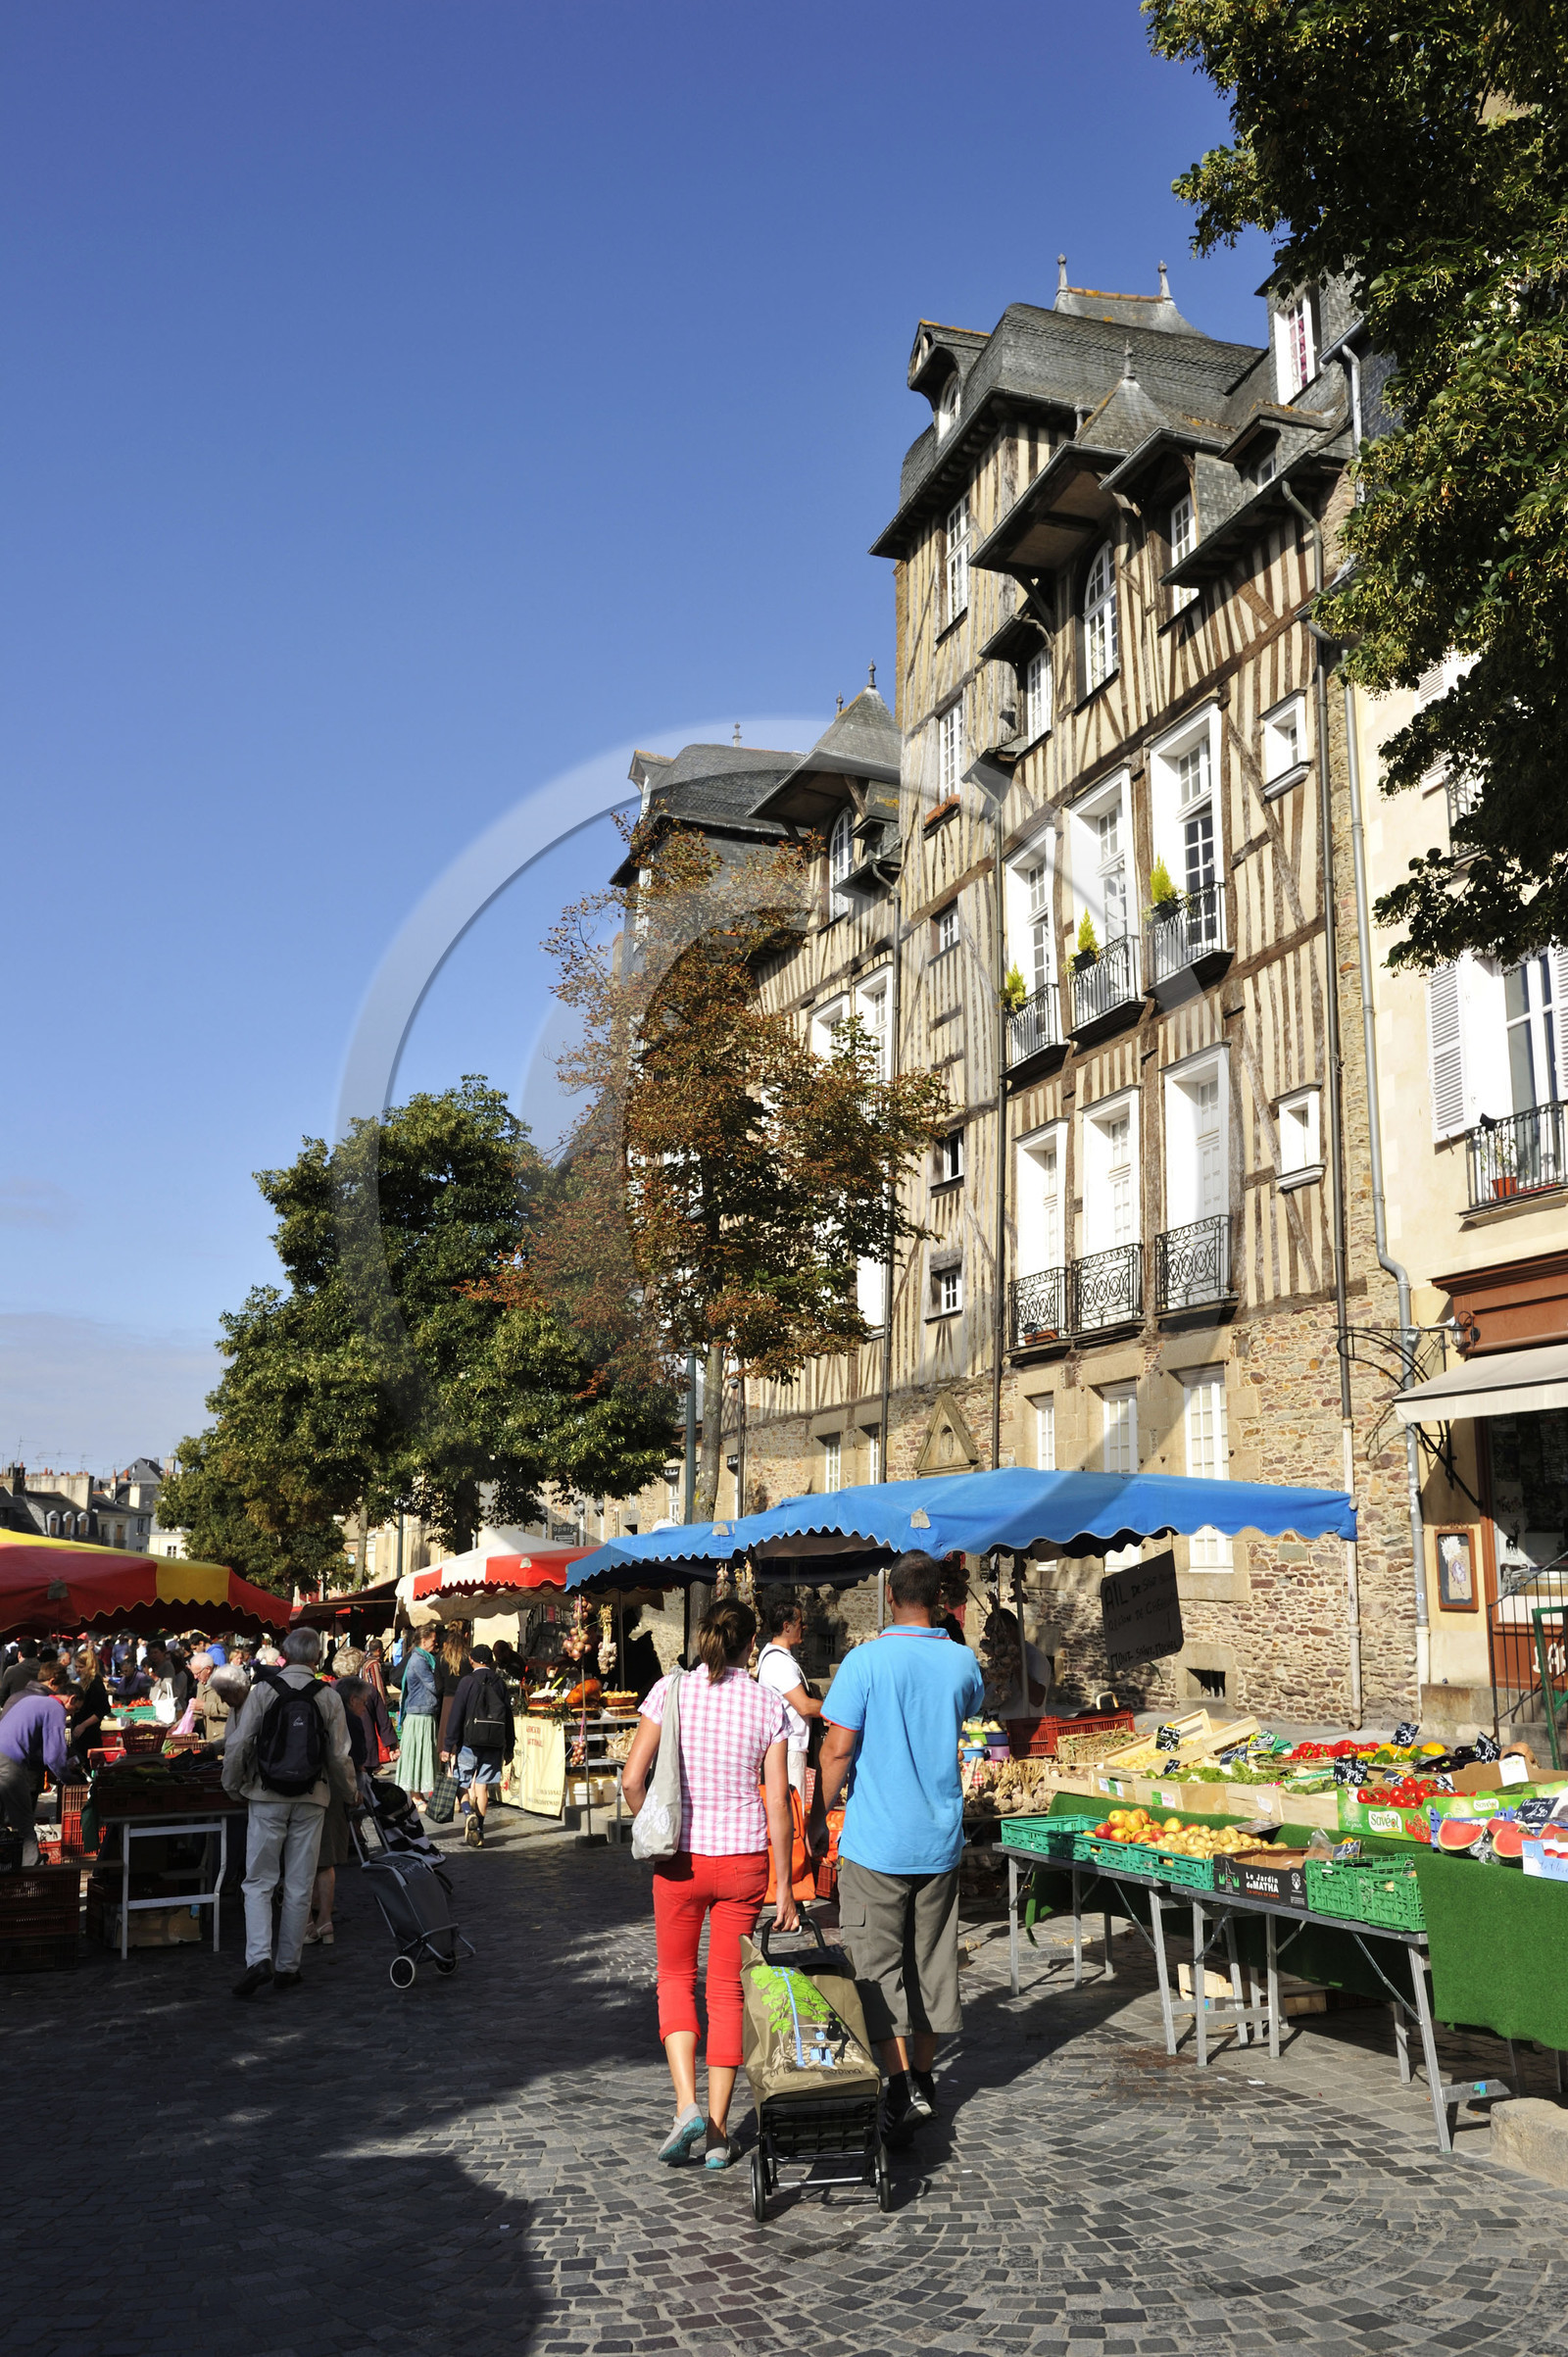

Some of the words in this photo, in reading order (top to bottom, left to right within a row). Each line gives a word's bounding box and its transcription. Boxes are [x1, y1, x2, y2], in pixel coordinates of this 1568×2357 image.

[1370, 1813, 1400, 1830] Savéol
[1246, 1871, 1254, 1881] Le
[1256, 1873, 1279, 1885] Jardin
